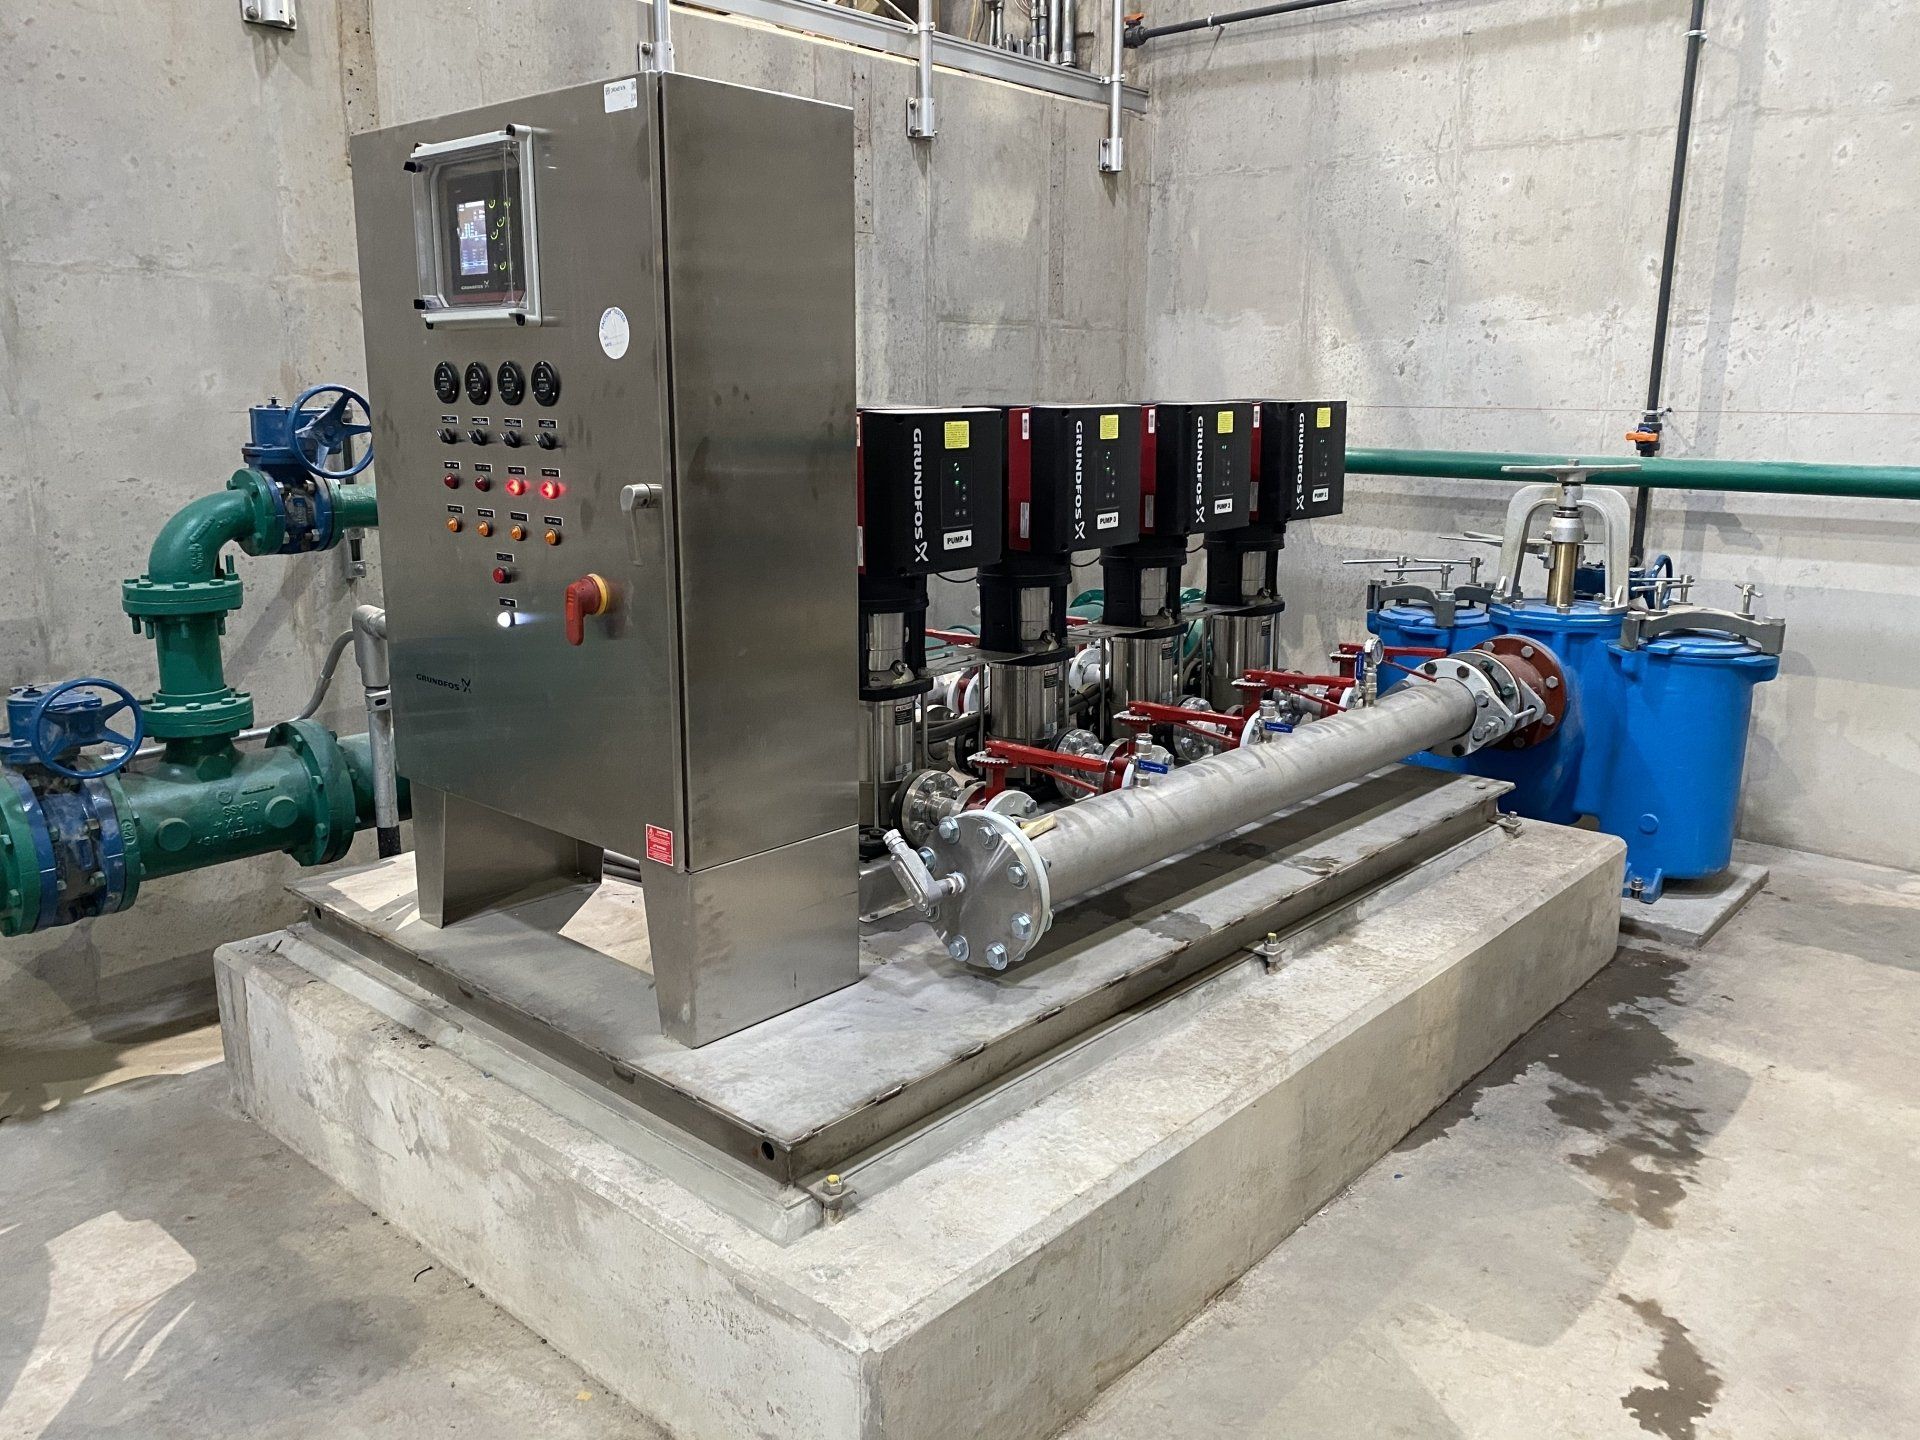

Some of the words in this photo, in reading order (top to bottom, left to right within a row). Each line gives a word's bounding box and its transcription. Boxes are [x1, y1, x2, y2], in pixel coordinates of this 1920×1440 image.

[913, 428, 923, 540] GRUNDFOS
[1075, 420, 1083, 520] GRUNDFOS
[1195, 415, 1204, 505] GRUNDFOS
[1296, 412, 1305, 494] GRUNDFOS
[946, 535, 964, 545] PUMP
[964, 534, 969, 542] 4
[416, 673, 460, 691] GRUNDFOS
